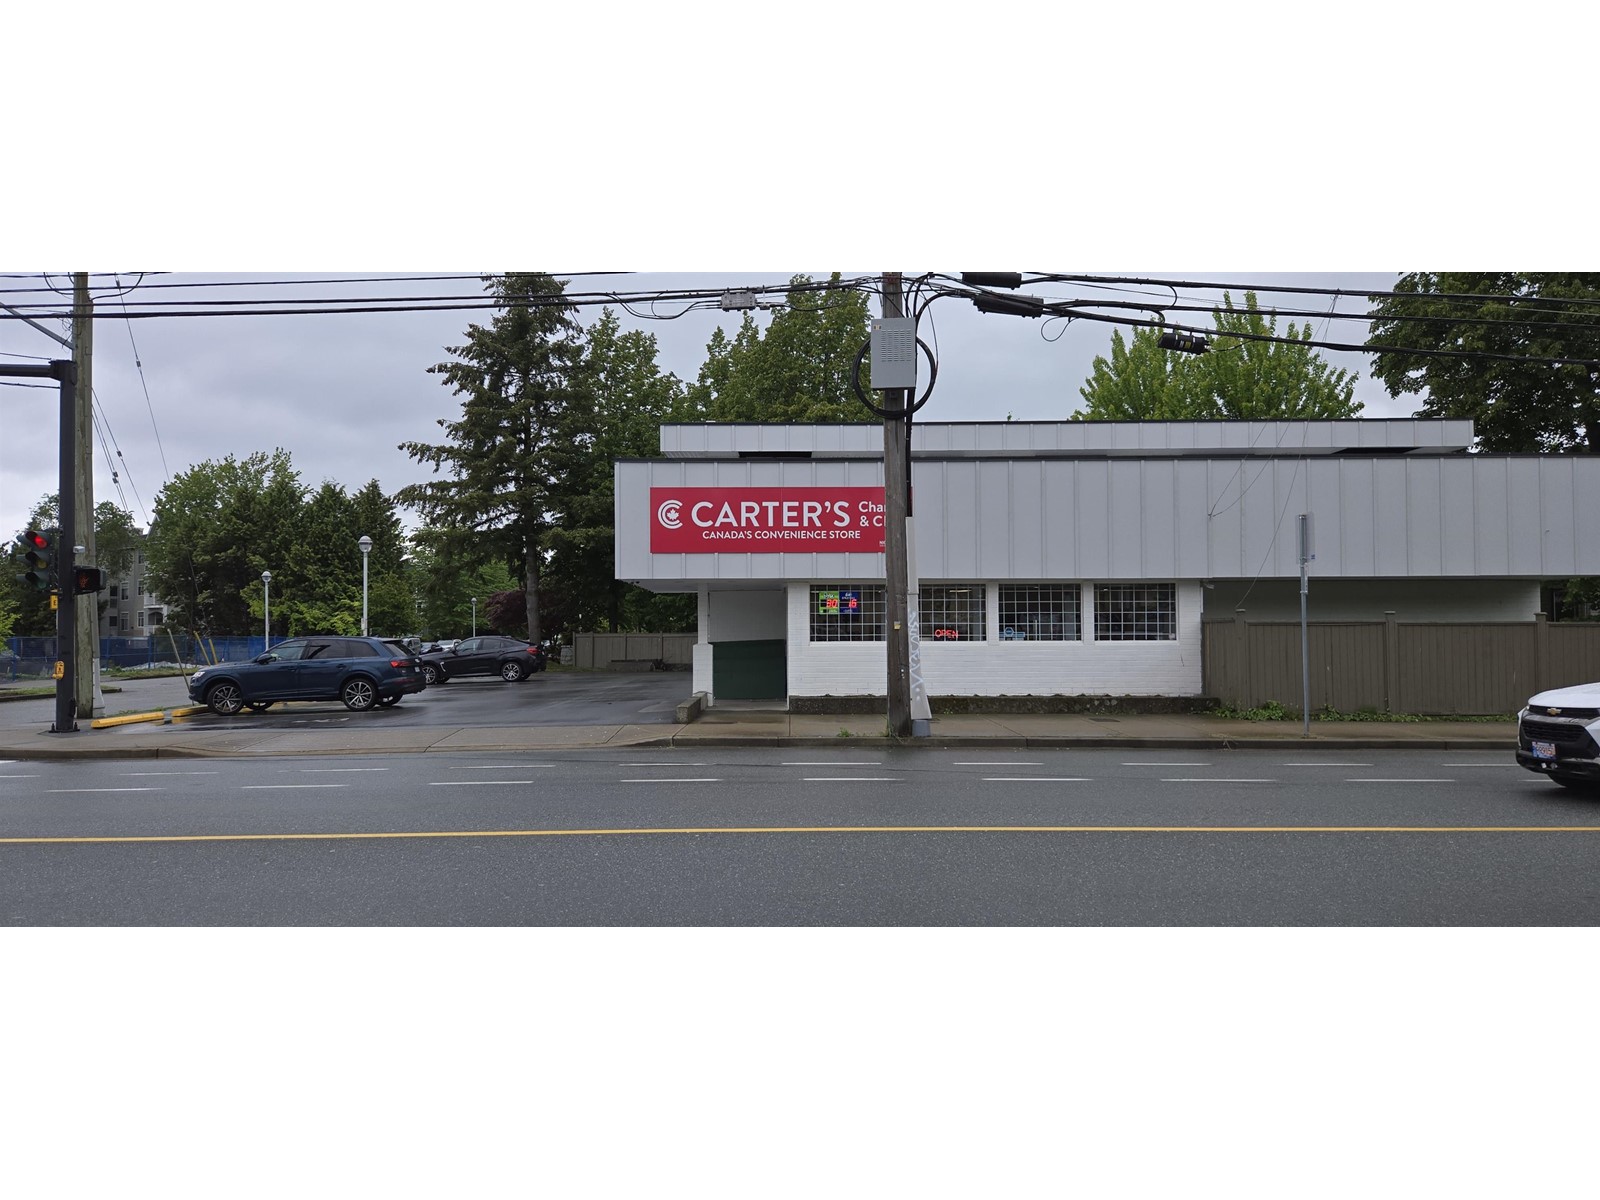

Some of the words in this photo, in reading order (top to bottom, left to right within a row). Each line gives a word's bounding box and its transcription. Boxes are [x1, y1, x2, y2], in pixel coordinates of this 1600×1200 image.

[691, 501, 850, 528] CARTER'S
[859, 515, 870, 527] &
[702, 530, 752, 540] CANADA'S
[754, 530, 827, 540] CONVENIENCE
[829, 530, 861, 540] STORE
[934, 629, 959, 639] OPEN
